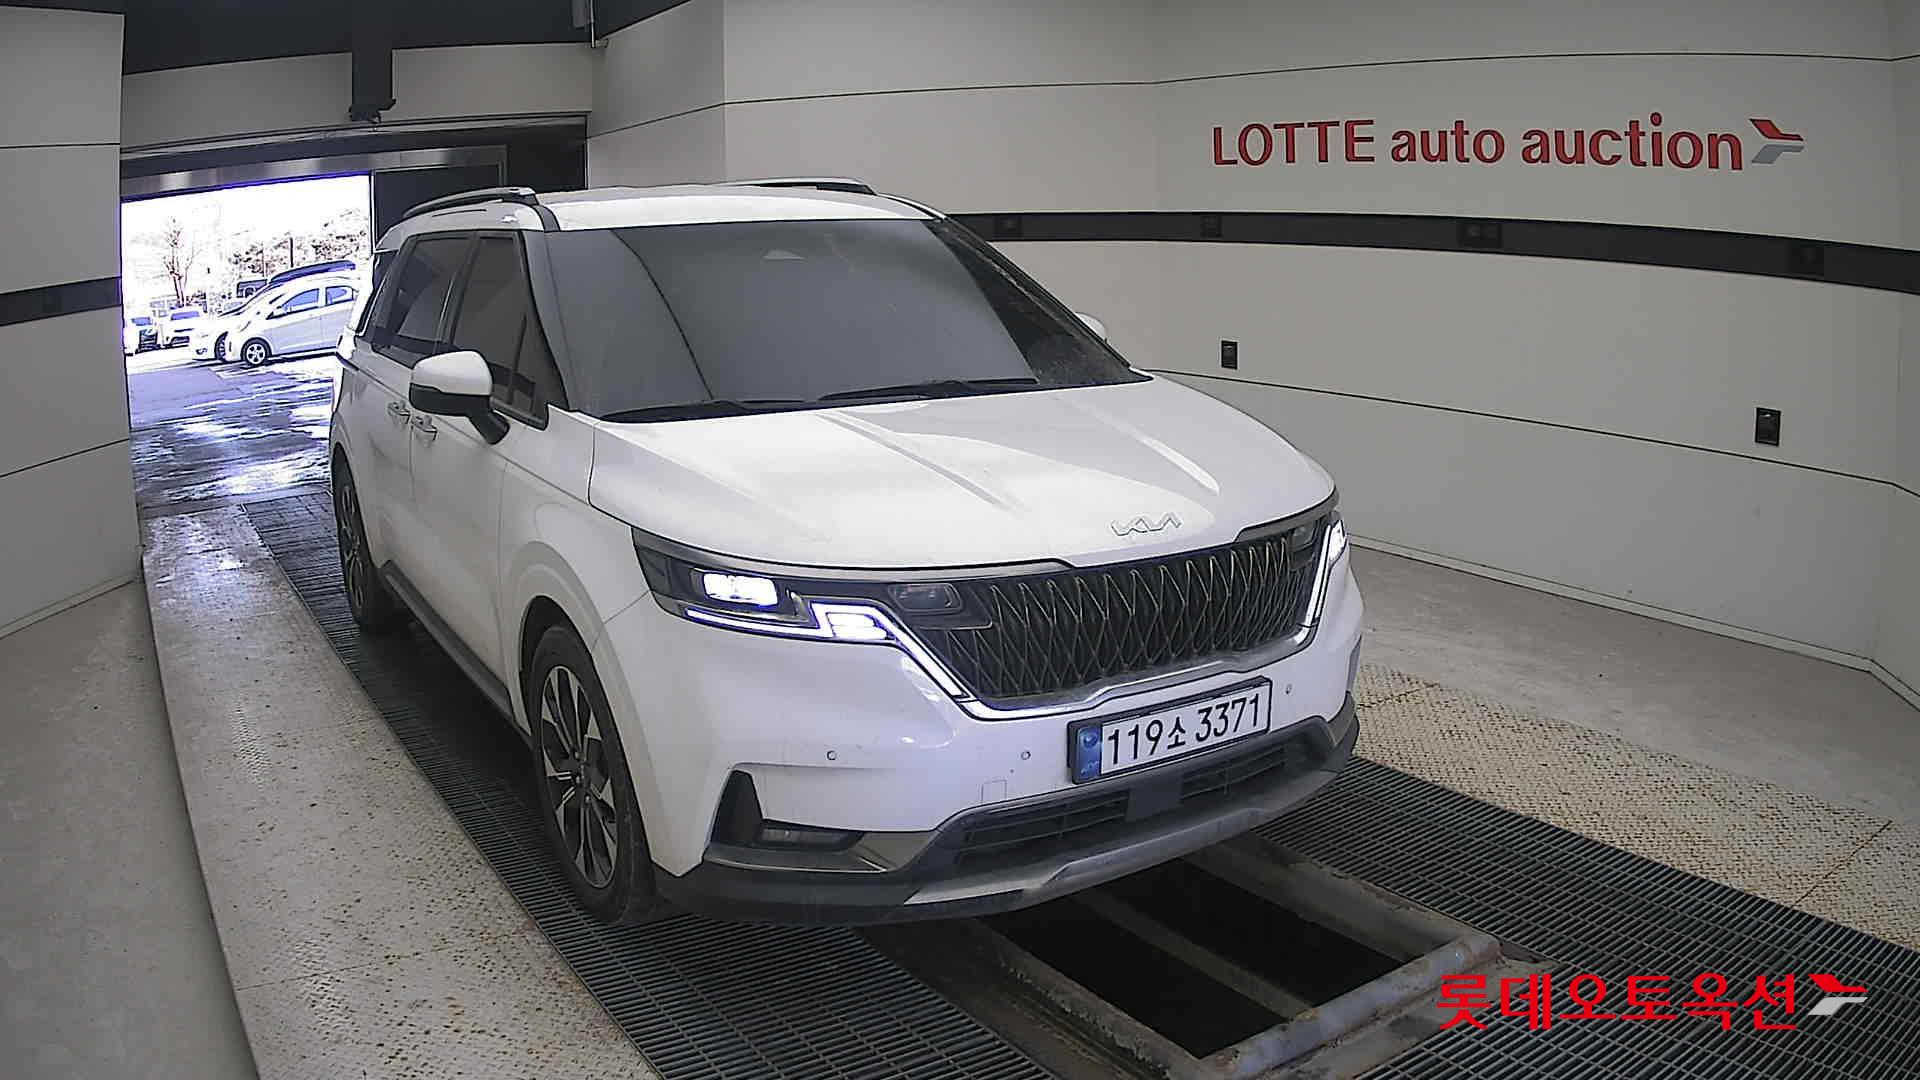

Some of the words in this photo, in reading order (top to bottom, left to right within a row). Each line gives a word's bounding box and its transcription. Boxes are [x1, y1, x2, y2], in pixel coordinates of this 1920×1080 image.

[1212, 119, 1376, 166] LOTTE
[1391, 119, 1505, 164] auto
[1520, 111, 1743, 171] auction
[1108, 716, 1186, 764] 119소
[1195, 692, 1260, 742] 3371
